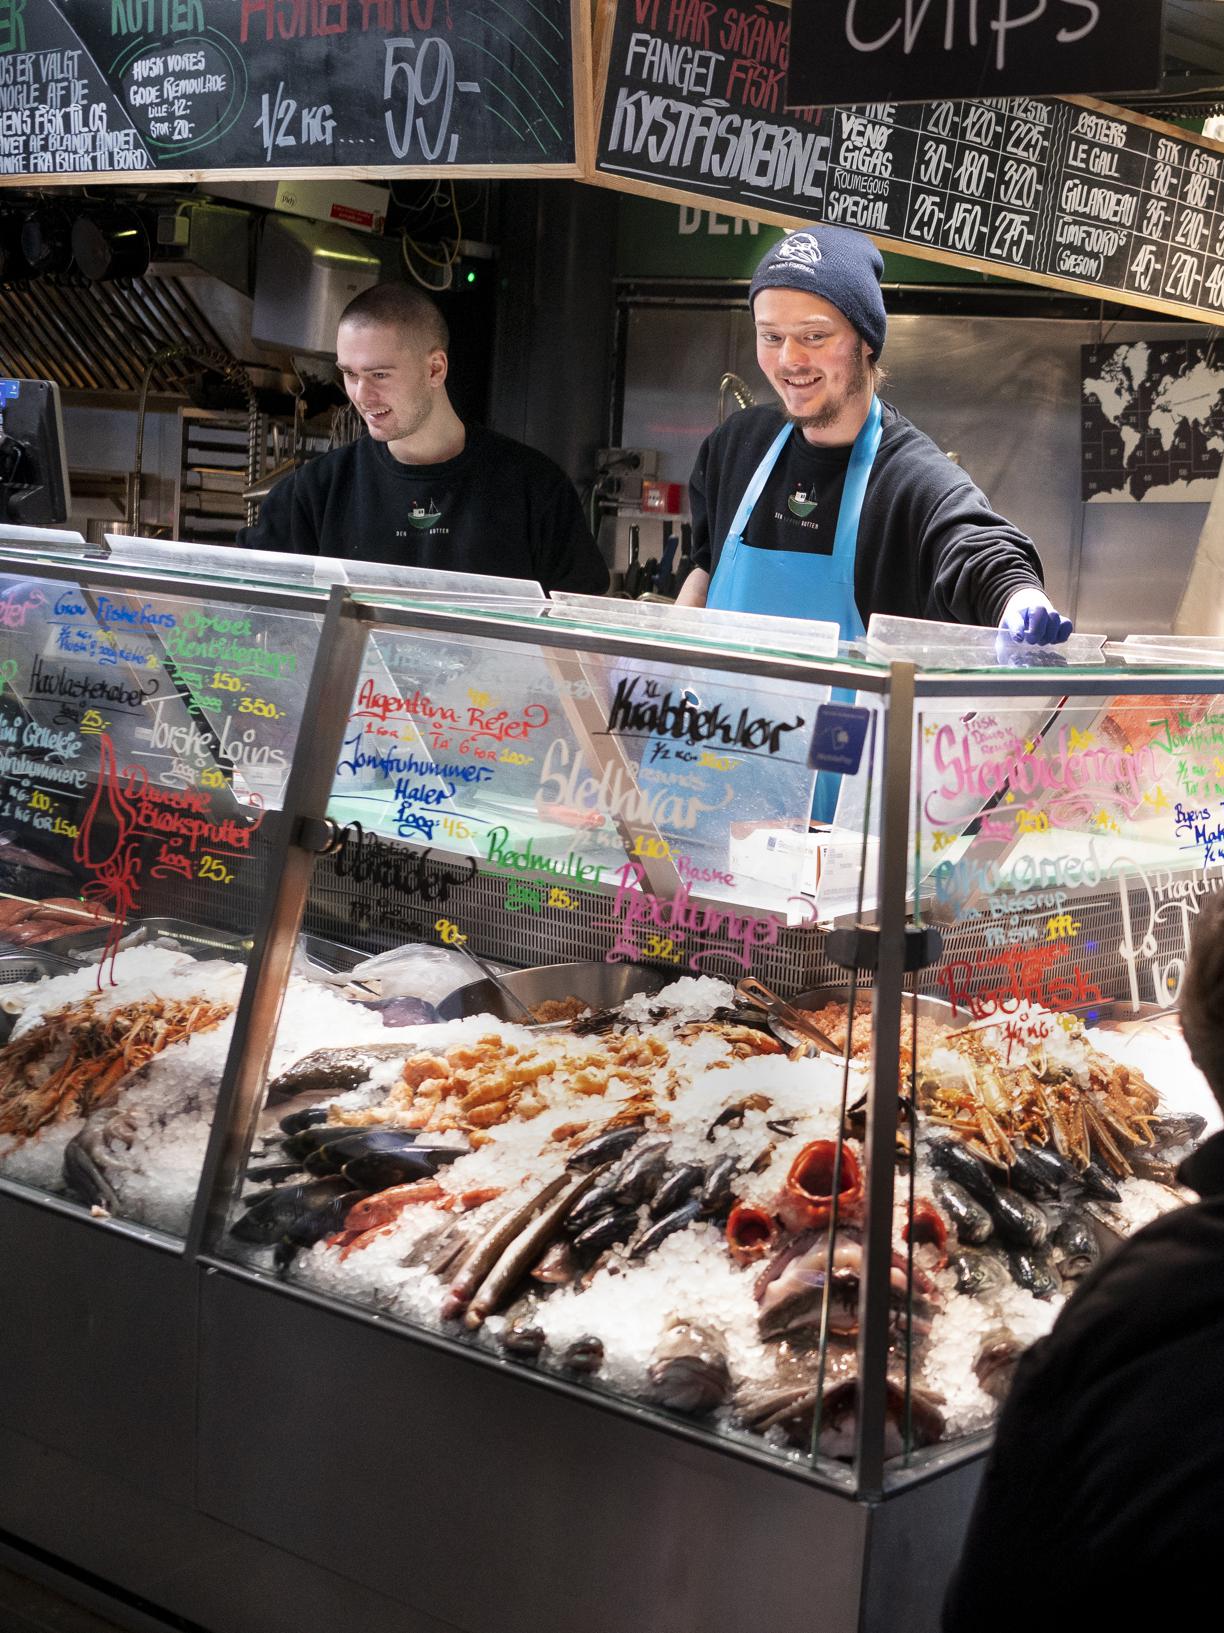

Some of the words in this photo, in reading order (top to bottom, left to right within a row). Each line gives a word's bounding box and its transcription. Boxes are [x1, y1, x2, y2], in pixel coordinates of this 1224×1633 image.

[667, 0, 718, 50] HAR
[16, 53, 33, 84] ER
[39, 50, 82, 82] VALGT
[132, 59, 164, 81] HUSK
[167, 51, 206, 73] VORES
[625, 32, 726, 96] FANGET
[725, 57, 787, 113] FISK
[47, 81, 68, 109] AF
[70, 79, 89, 105] DE
[129, 85, 161, 107] GODE
[163, 74, 227, 101] REMOULADE
[29, 135, 45, 152] AF
[49, 132, 95, 151] BLANDT
[95, 128, 137, 151] ANDET
[608, 86, 831, 198] KYSTFISKERNE
[841, 112, 894, 150] VENØ
[1071, 111, 1128, 148] ØSTERS
[1157, 138, 1182, 164] STK
[30, 152, 53, 172] FRA
[55, 149, 95, 170] BUTIK
[91, 148, 113, 171] TIL
[1068, 141, 1089, 168] LE
[1090, 148, 1121, 178] GALL
[834, 168, 891, 197] ROUMEGOUS
[828, 191, 891, 231] SPECIAL
